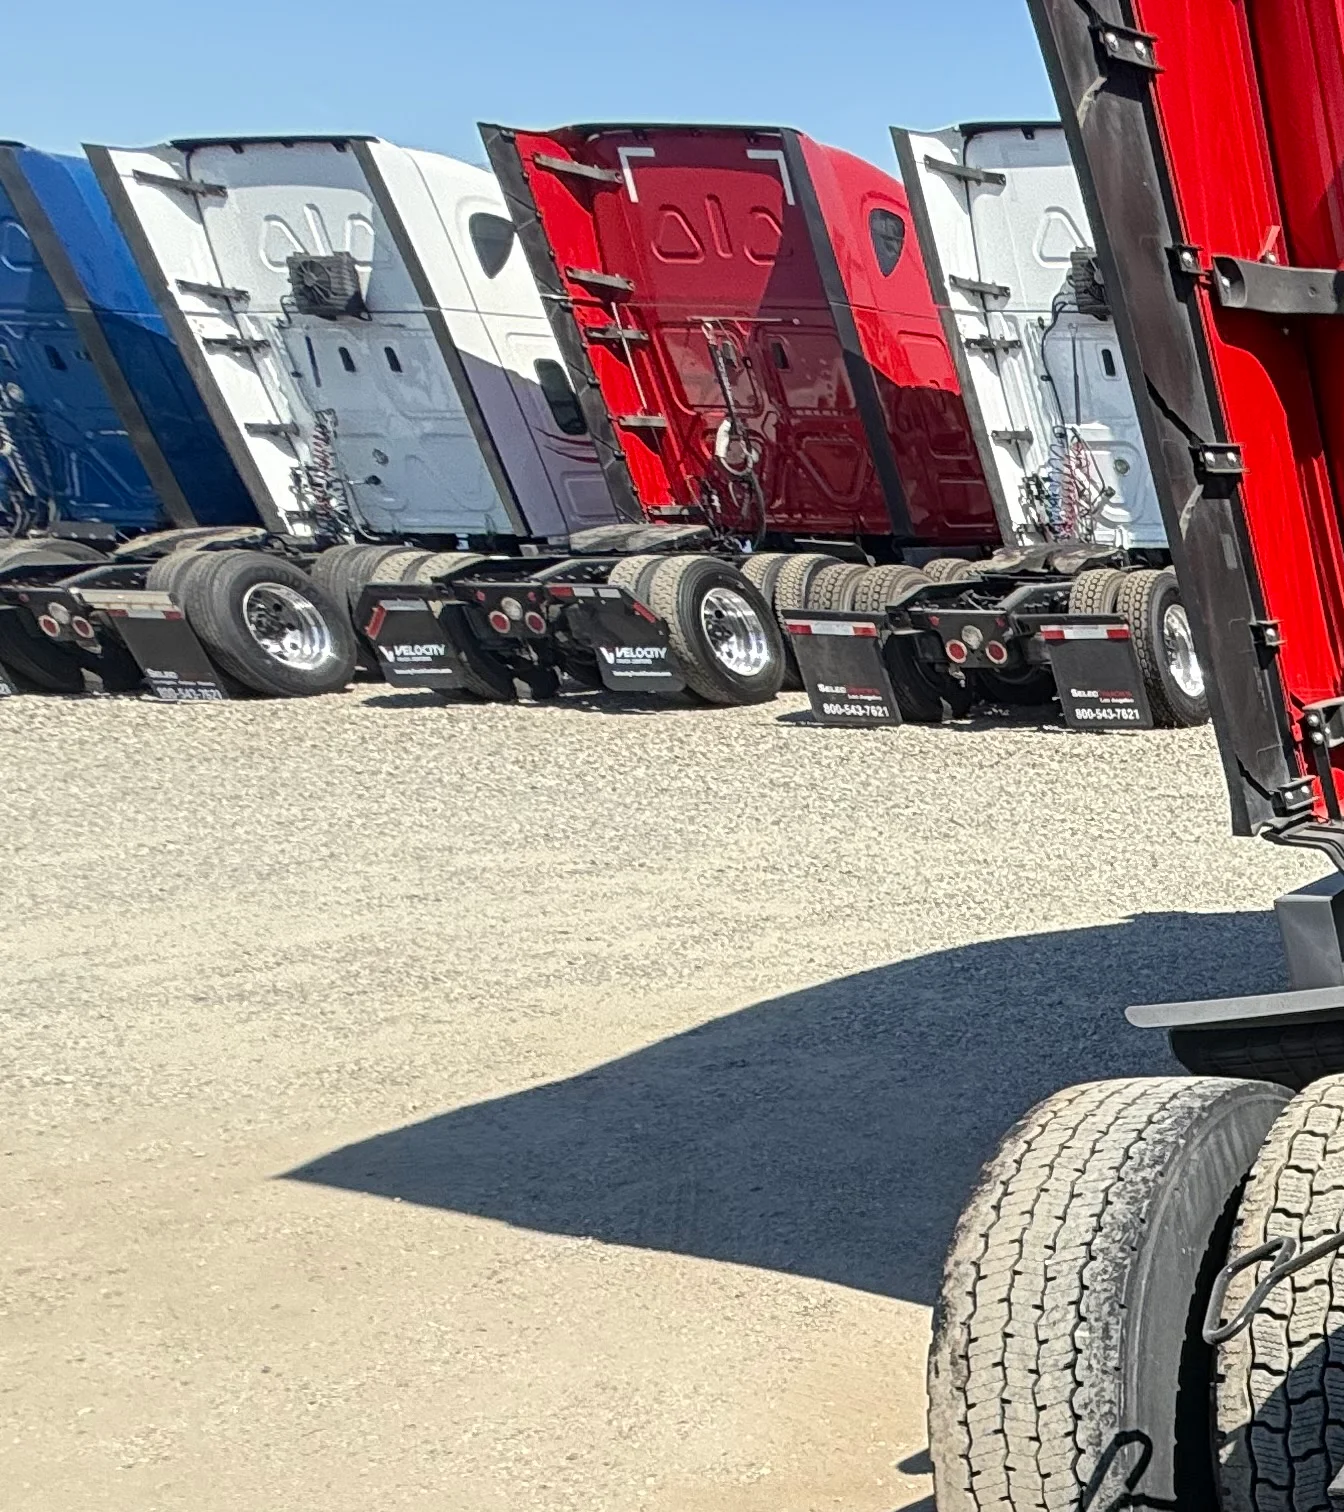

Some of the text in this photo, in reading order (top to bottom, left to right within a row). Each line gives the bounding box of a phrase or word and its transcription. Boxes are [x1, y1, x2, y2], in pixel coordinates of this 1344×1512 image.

[393, 644, 446, 656] VELOCITY
[615, 646, 667, 659] VELOCITY
[823, 703, 889, 717] 800-543-7621
[1075, 708, 1140, 720] 800-543-7621
